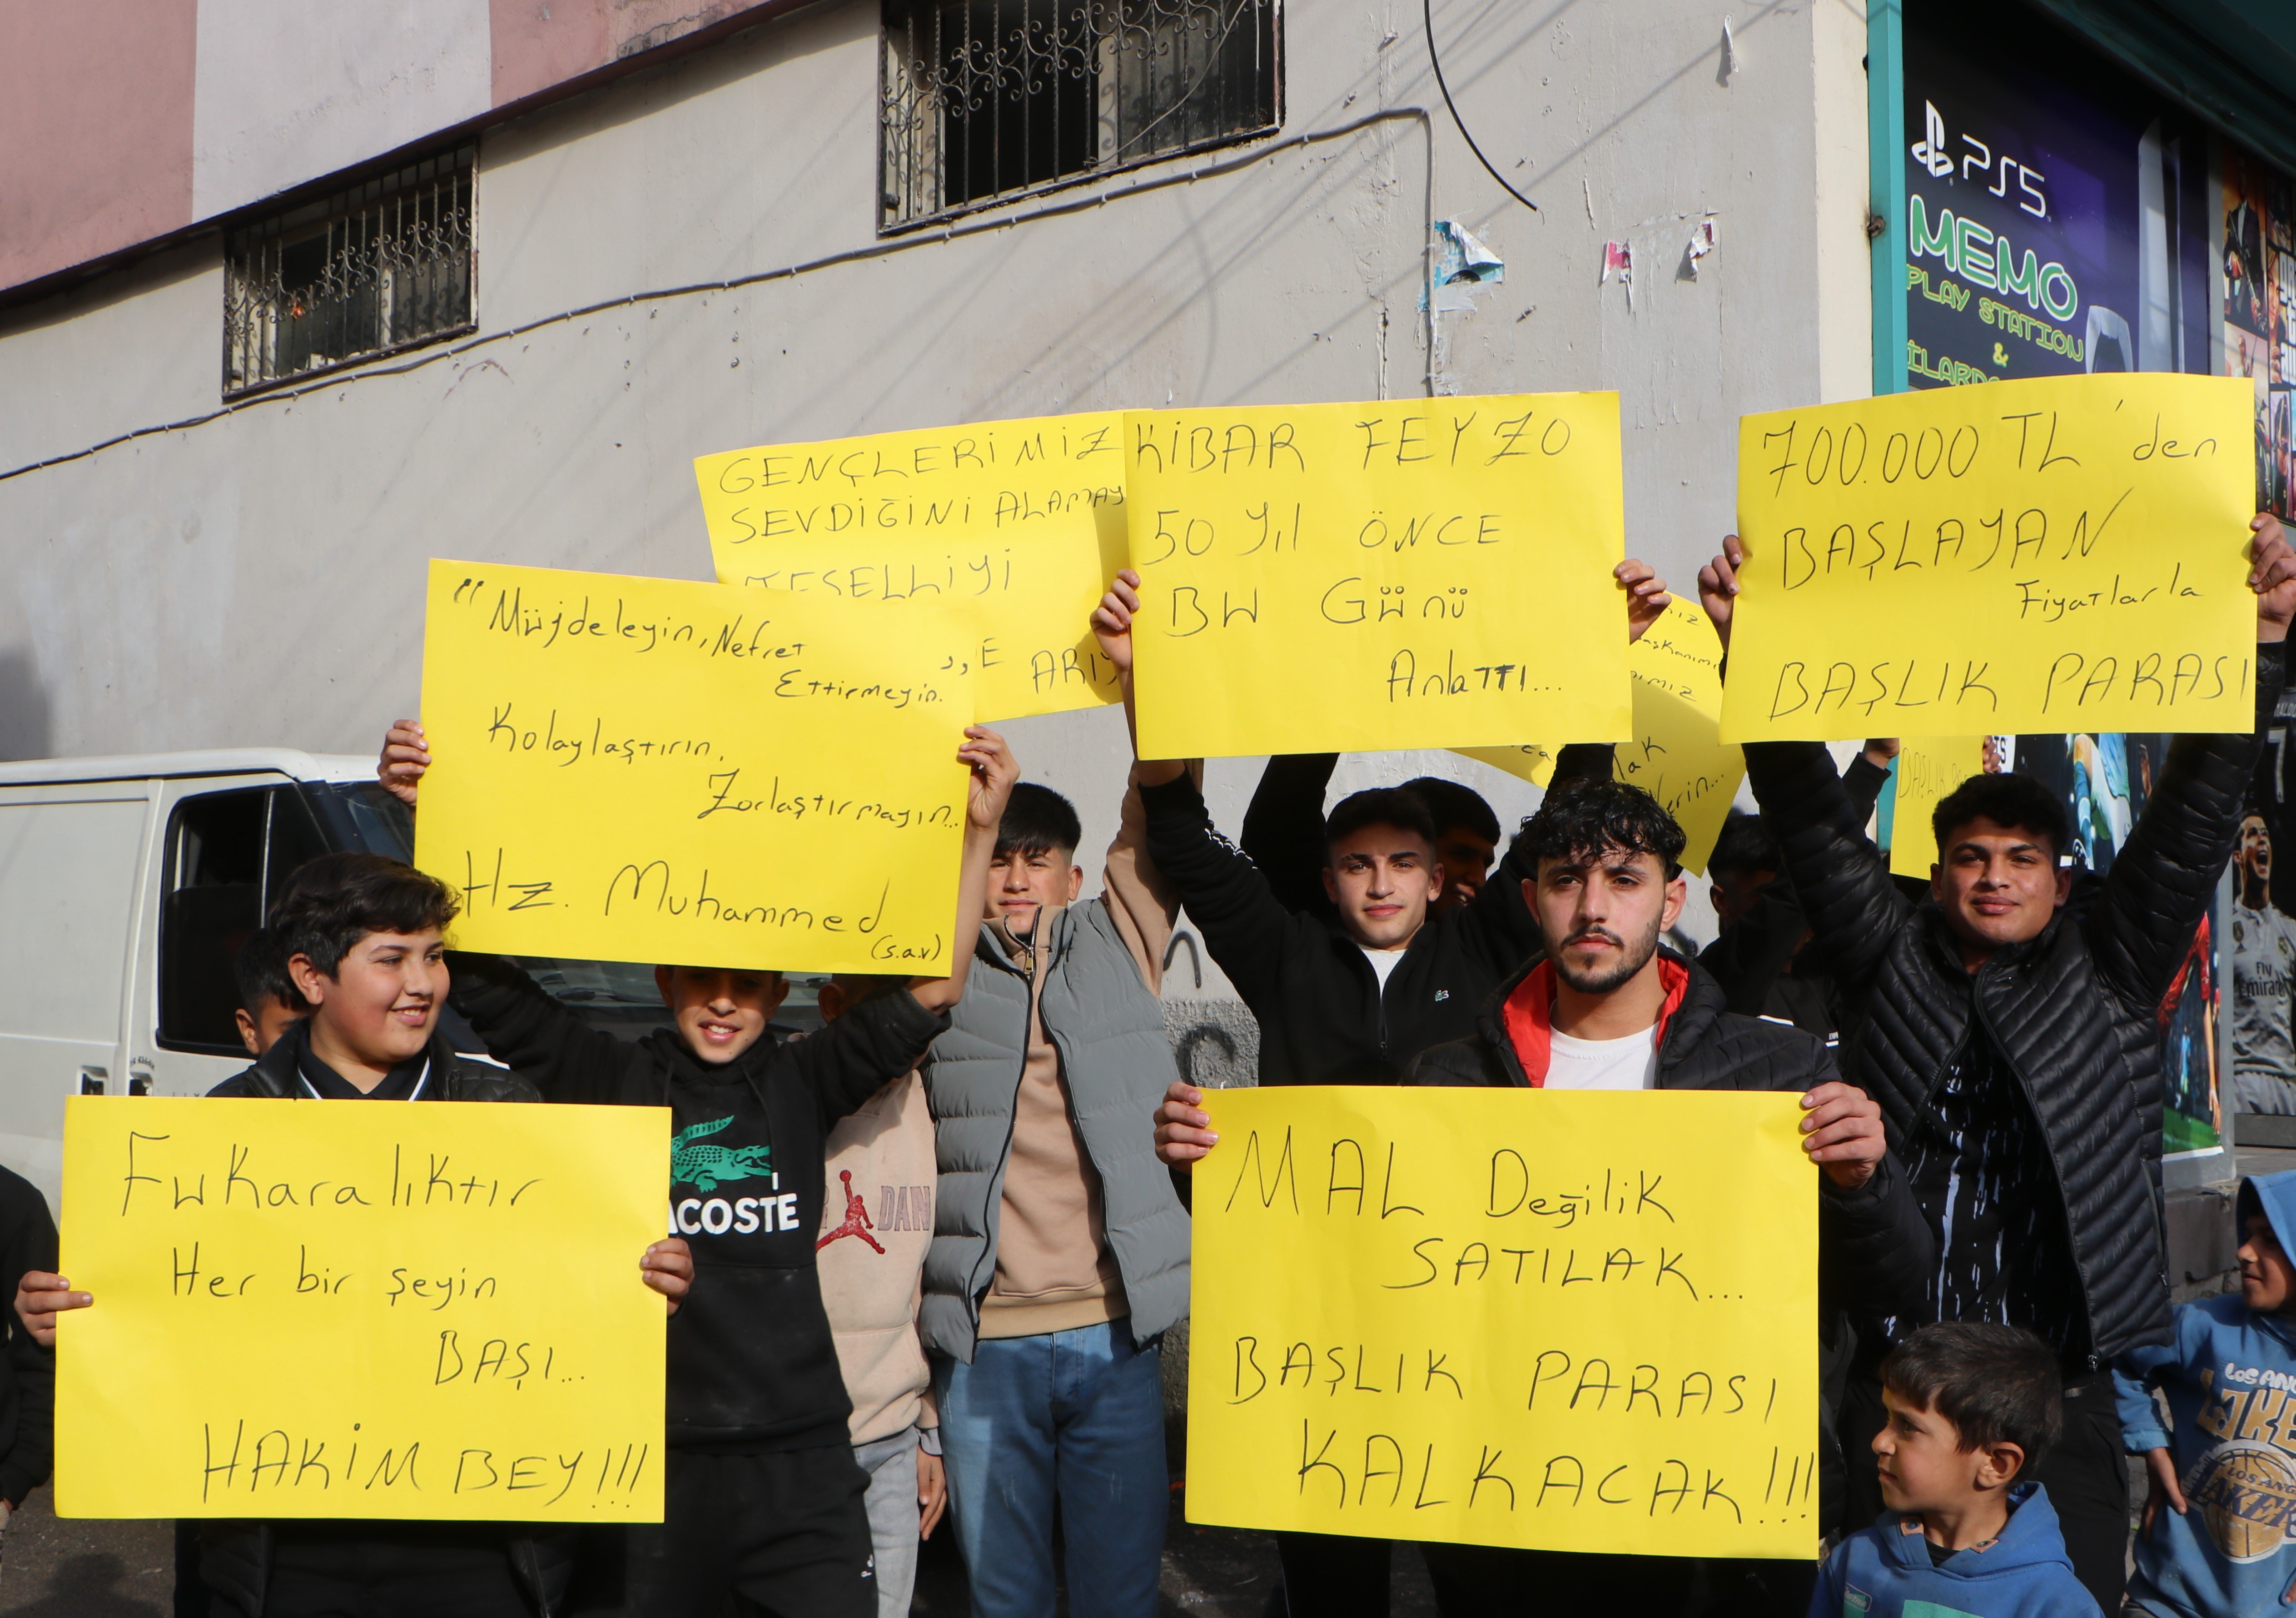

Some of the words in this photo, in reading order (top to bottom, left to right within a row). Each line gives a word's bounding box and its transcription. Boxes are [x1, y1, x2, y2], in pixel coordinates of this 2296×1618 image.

[1962, 134, 2047, 219] PS5
[1910, 193, 2078, 322] MEMO
[1906, 264, 1970, 312] PLAY
[1979, 297, 2084, 363] STATION
[1907, 339, 2000, 386] İLARD
[1993, 342, 2009, 368] &
[720, 426, 1123, 494] GENÇLERİMİZ
[1138, 421, 1304, 473] KİBAR
[1355, 411, 1570, 469] FEYZO
[1764, 420, 1978, 497] 700.000
[2002, 411, 2080, 472] TL
[729, 495, 971, 544] SEVDİĞİNİ
[995, 486, 1123, 528] ALAMAY
[1144, 510, 1213, 565] 50
[1360, 511, 1499, 552] ÖNCE
[1783, 487, 2133, 590] BAŞLAYAN
[1321, 578, 1467, 624] Günü
[711, 615, 804, 659] Nefret
[1031, 648, 1117, 694] ARIY
[1769, 660, 1997, 722] BAŞLIK
[2043, 653, 2247, 714] PARASI
[462, 847, 569, 917] Hz.
[605, 860, 891, 934] Muhammed
[1225, 1125, 1424, 1220] MAL
[1486, 1149, 1675, 1229] Değilik
[174, 1241, 255, 1297] Her
[296, 1245, 351, 1294] bir
[387, 1268, 496, 1310] şeyin
[1382, 1238, 1742, 1301] SATILAK...
[435, 1330, 584, 1390] BAŞI...
[1227, 1336, 1463, 1404] BAŞLIK
[1528, 1350, 1776, 1422] PARASI
[2196, 1368, 2296, 1456] LAKE
[204, 1419, 419, 1503] HAKİM
[1298, 1418, 1814, 1524] KALKACAK!!!
[2227, 1467, 2257, 1483] LOS
